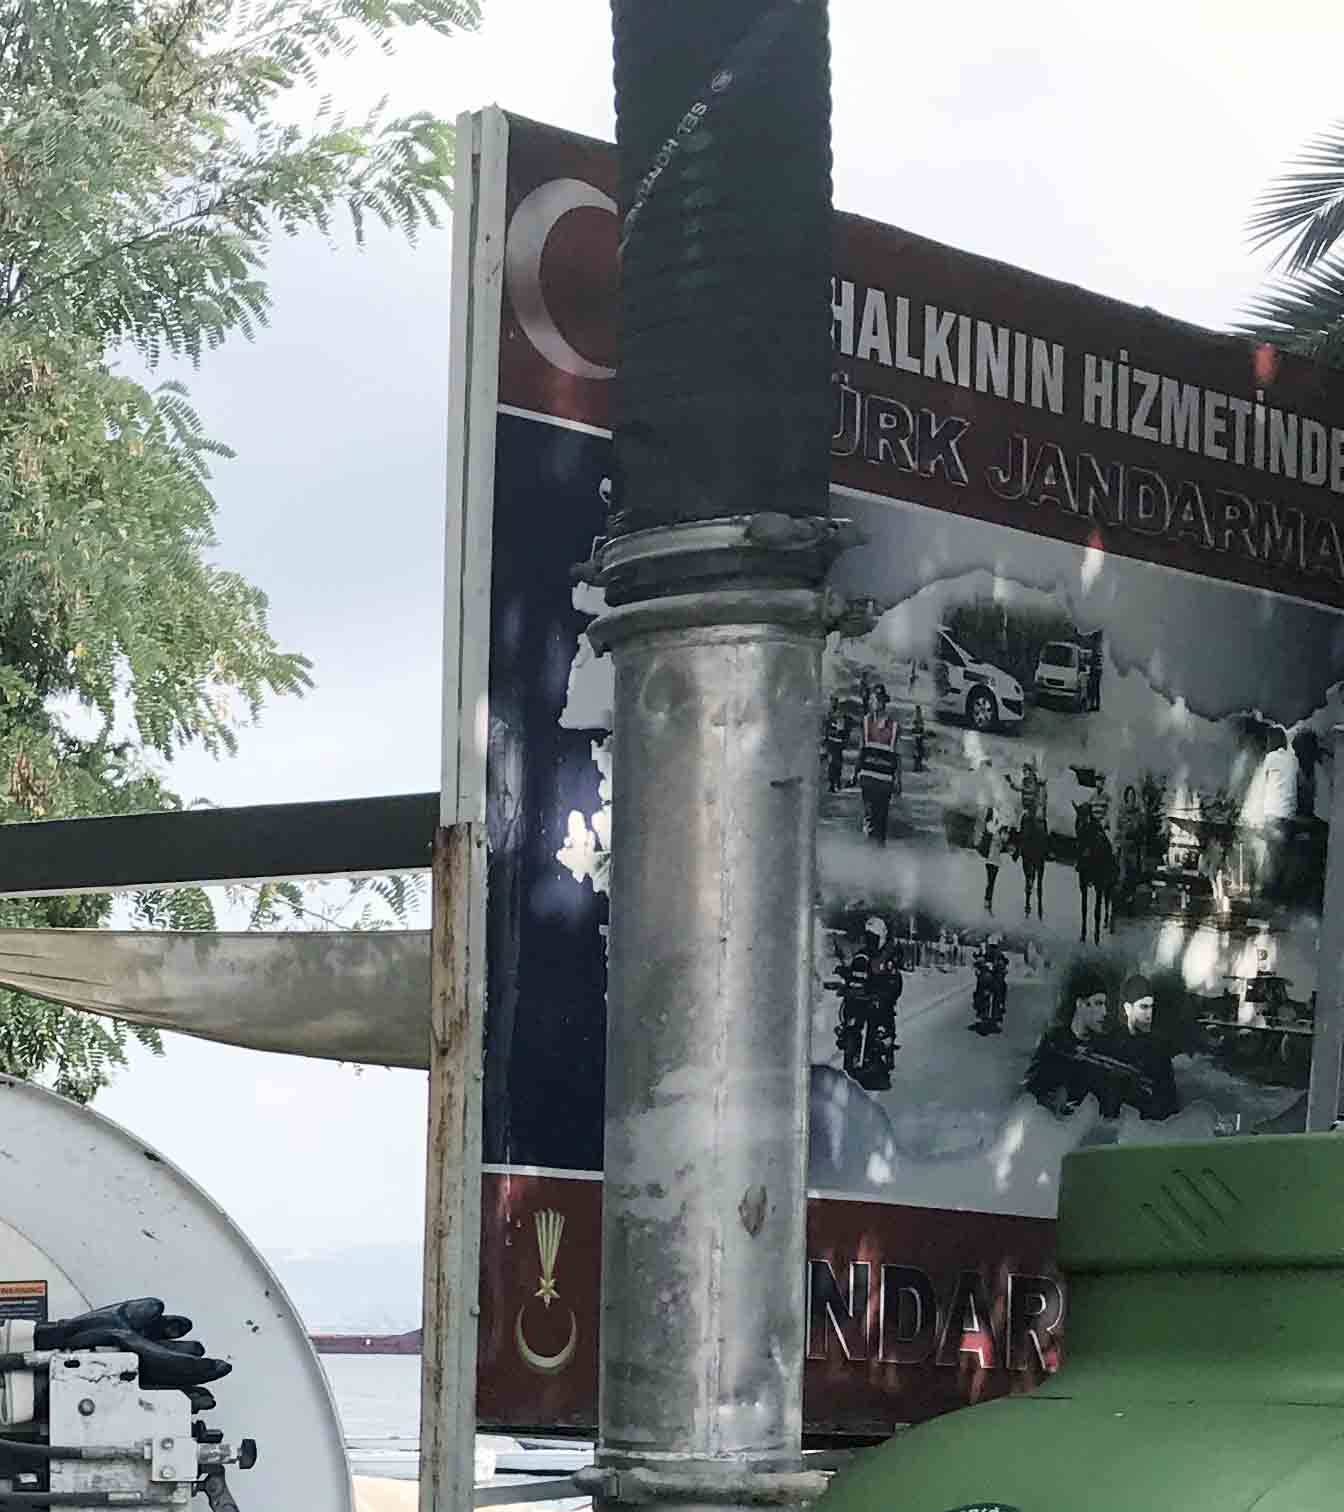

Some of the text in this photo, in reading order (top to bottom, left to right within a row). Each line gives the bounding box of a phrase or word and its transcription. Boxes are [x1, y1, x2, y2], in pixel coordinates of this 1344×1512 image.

[830, 275, 1344, 494] HALKININ HİZMETİNDE
[830, 370, 1344, 584] ÜRK JANDARMA
[808, 1258, 1065, 1373] NDAR
